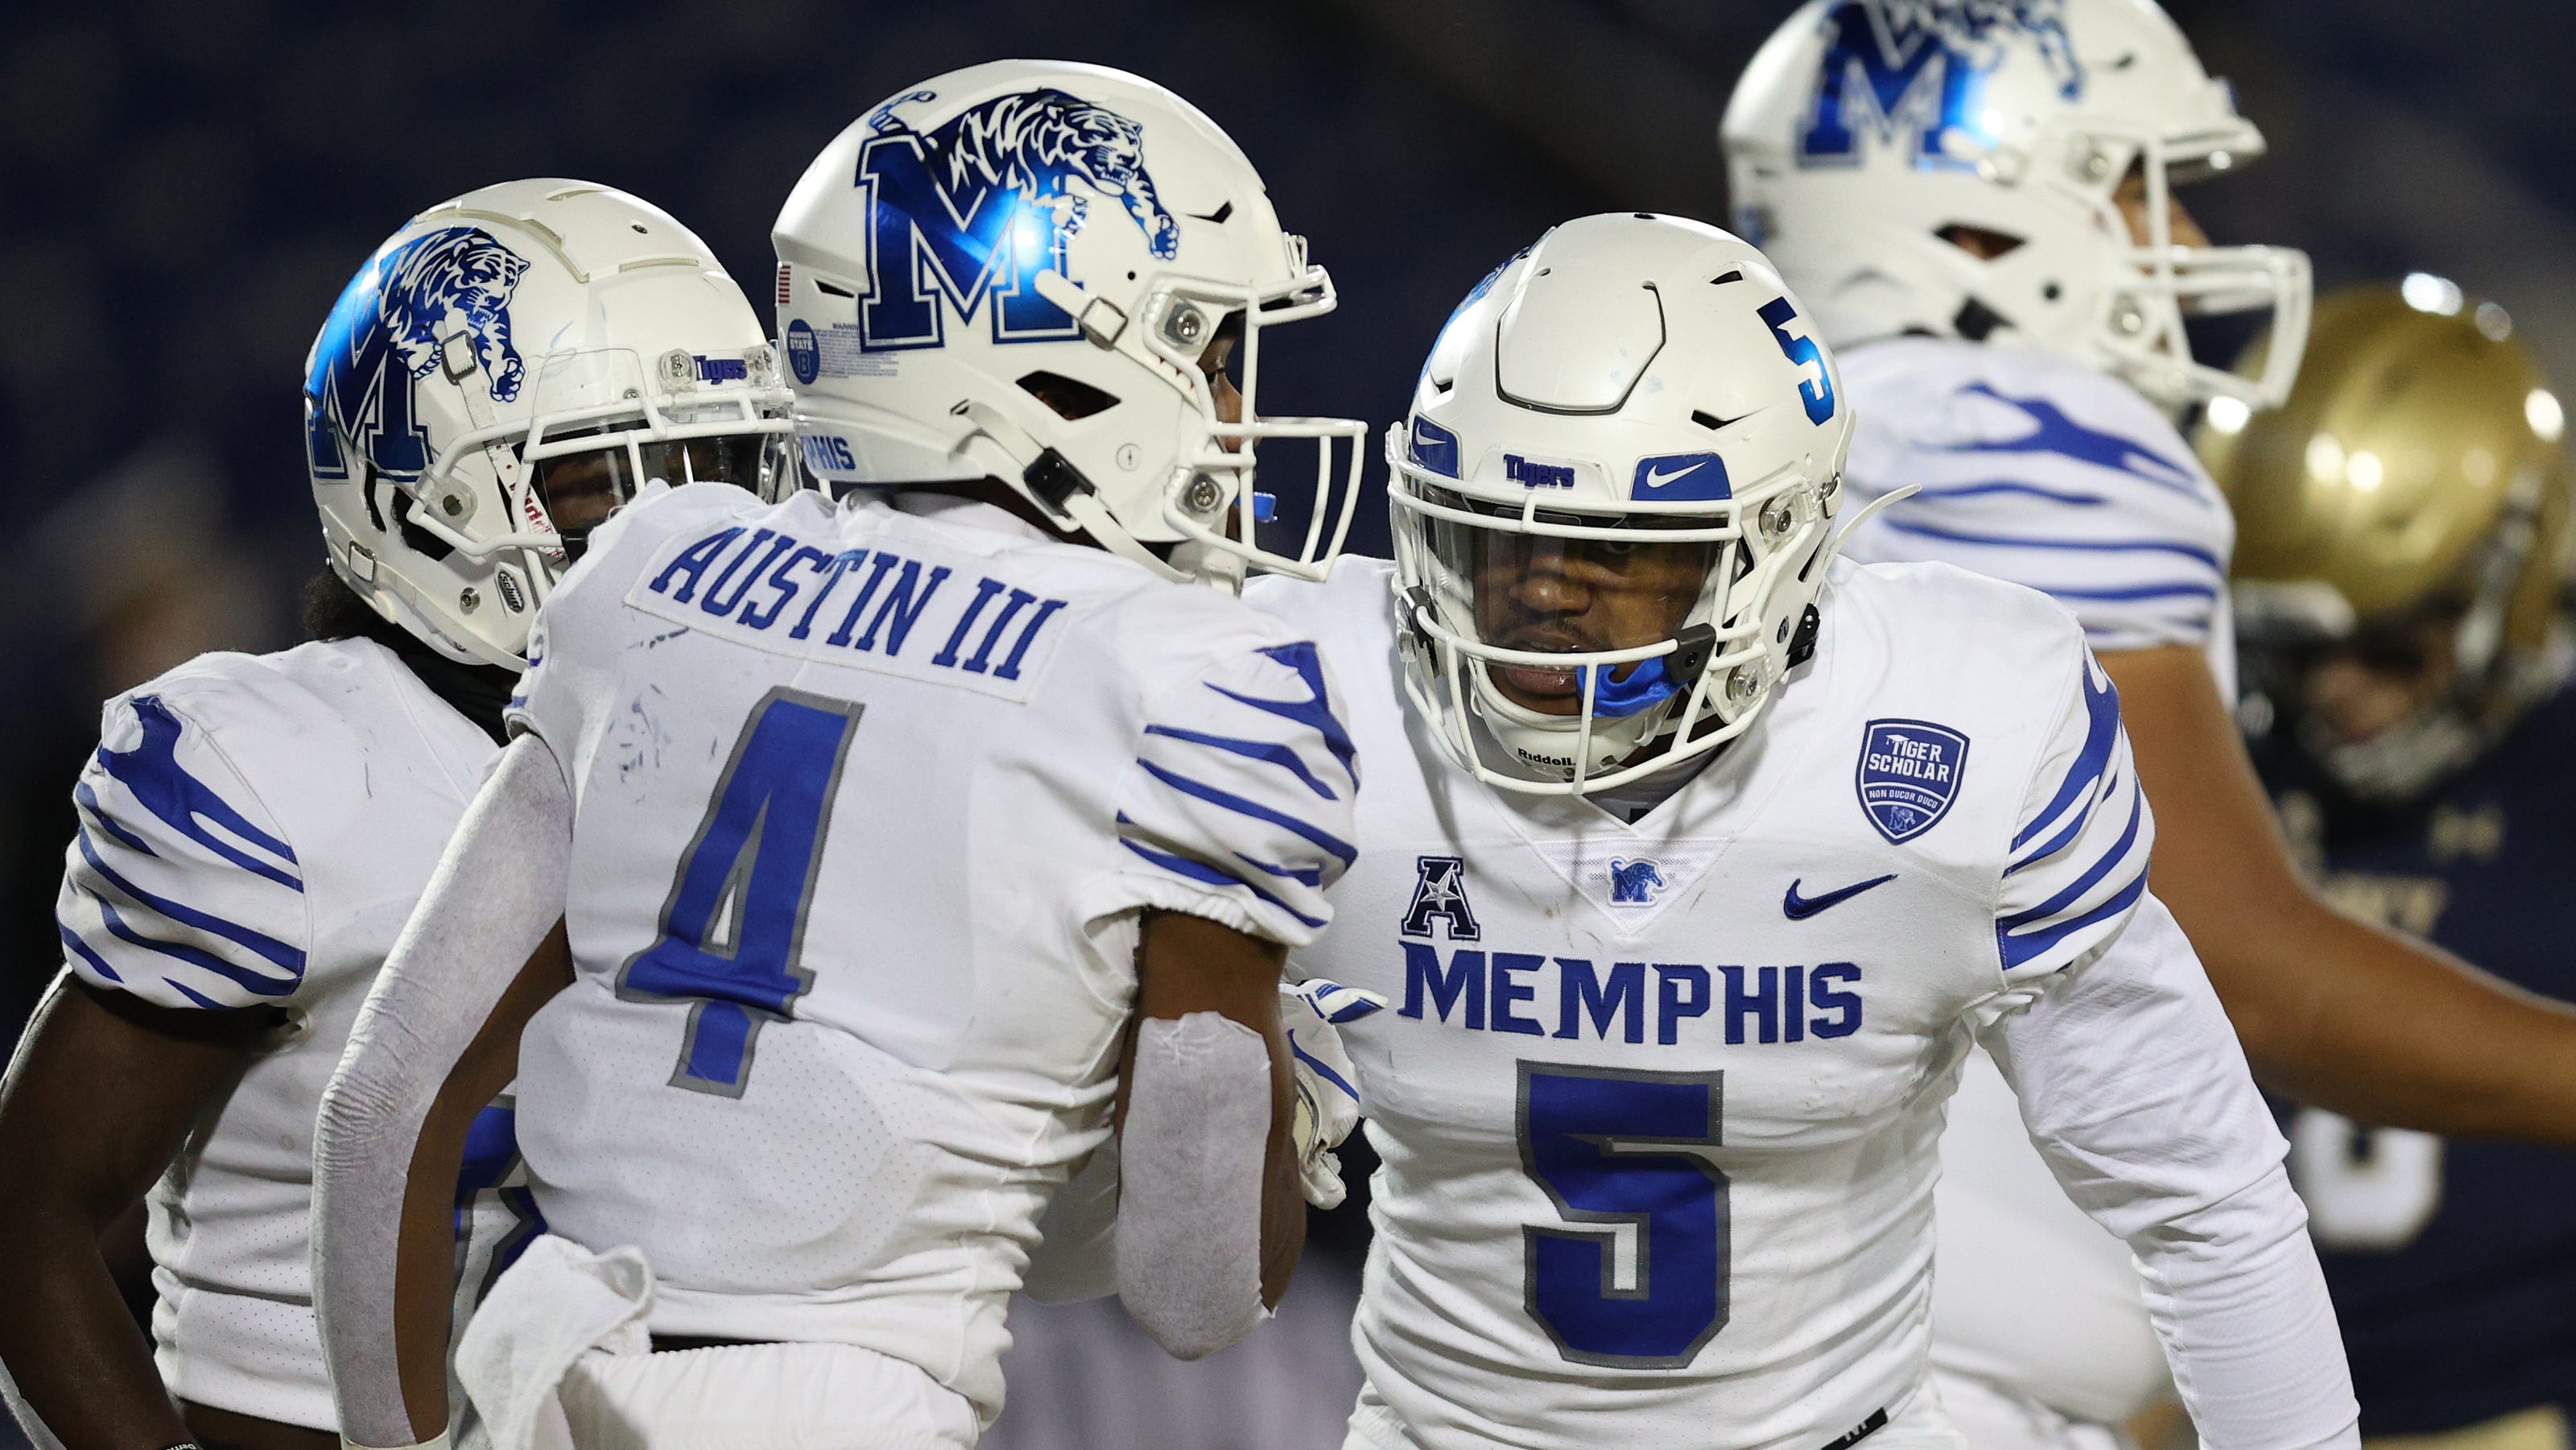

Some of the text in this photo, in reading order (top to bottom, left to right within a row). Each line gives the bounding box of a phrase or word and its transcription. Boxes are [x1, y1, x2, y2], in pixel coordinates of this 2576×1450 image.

[855, 133, 1086, 353] M
[1757, 296, 1835, 426] 5
[1503, 453, 1575, 488] Tigers
[649, 527, 1068, 681] AUSTIN III
[1868, 753, 1951, 783] SCHOLAR
[1869, 789, 1938, 809] NON DUCOR DUCO
[1892, 737, 1942, 762] TIGER
[615, 685, 866, 1100] 4
[1402, 856, 1480, 940] A
[1397, 939, 1863, 1046] MEMPHIS
[1516, 1059, 1731, 1369] 5
